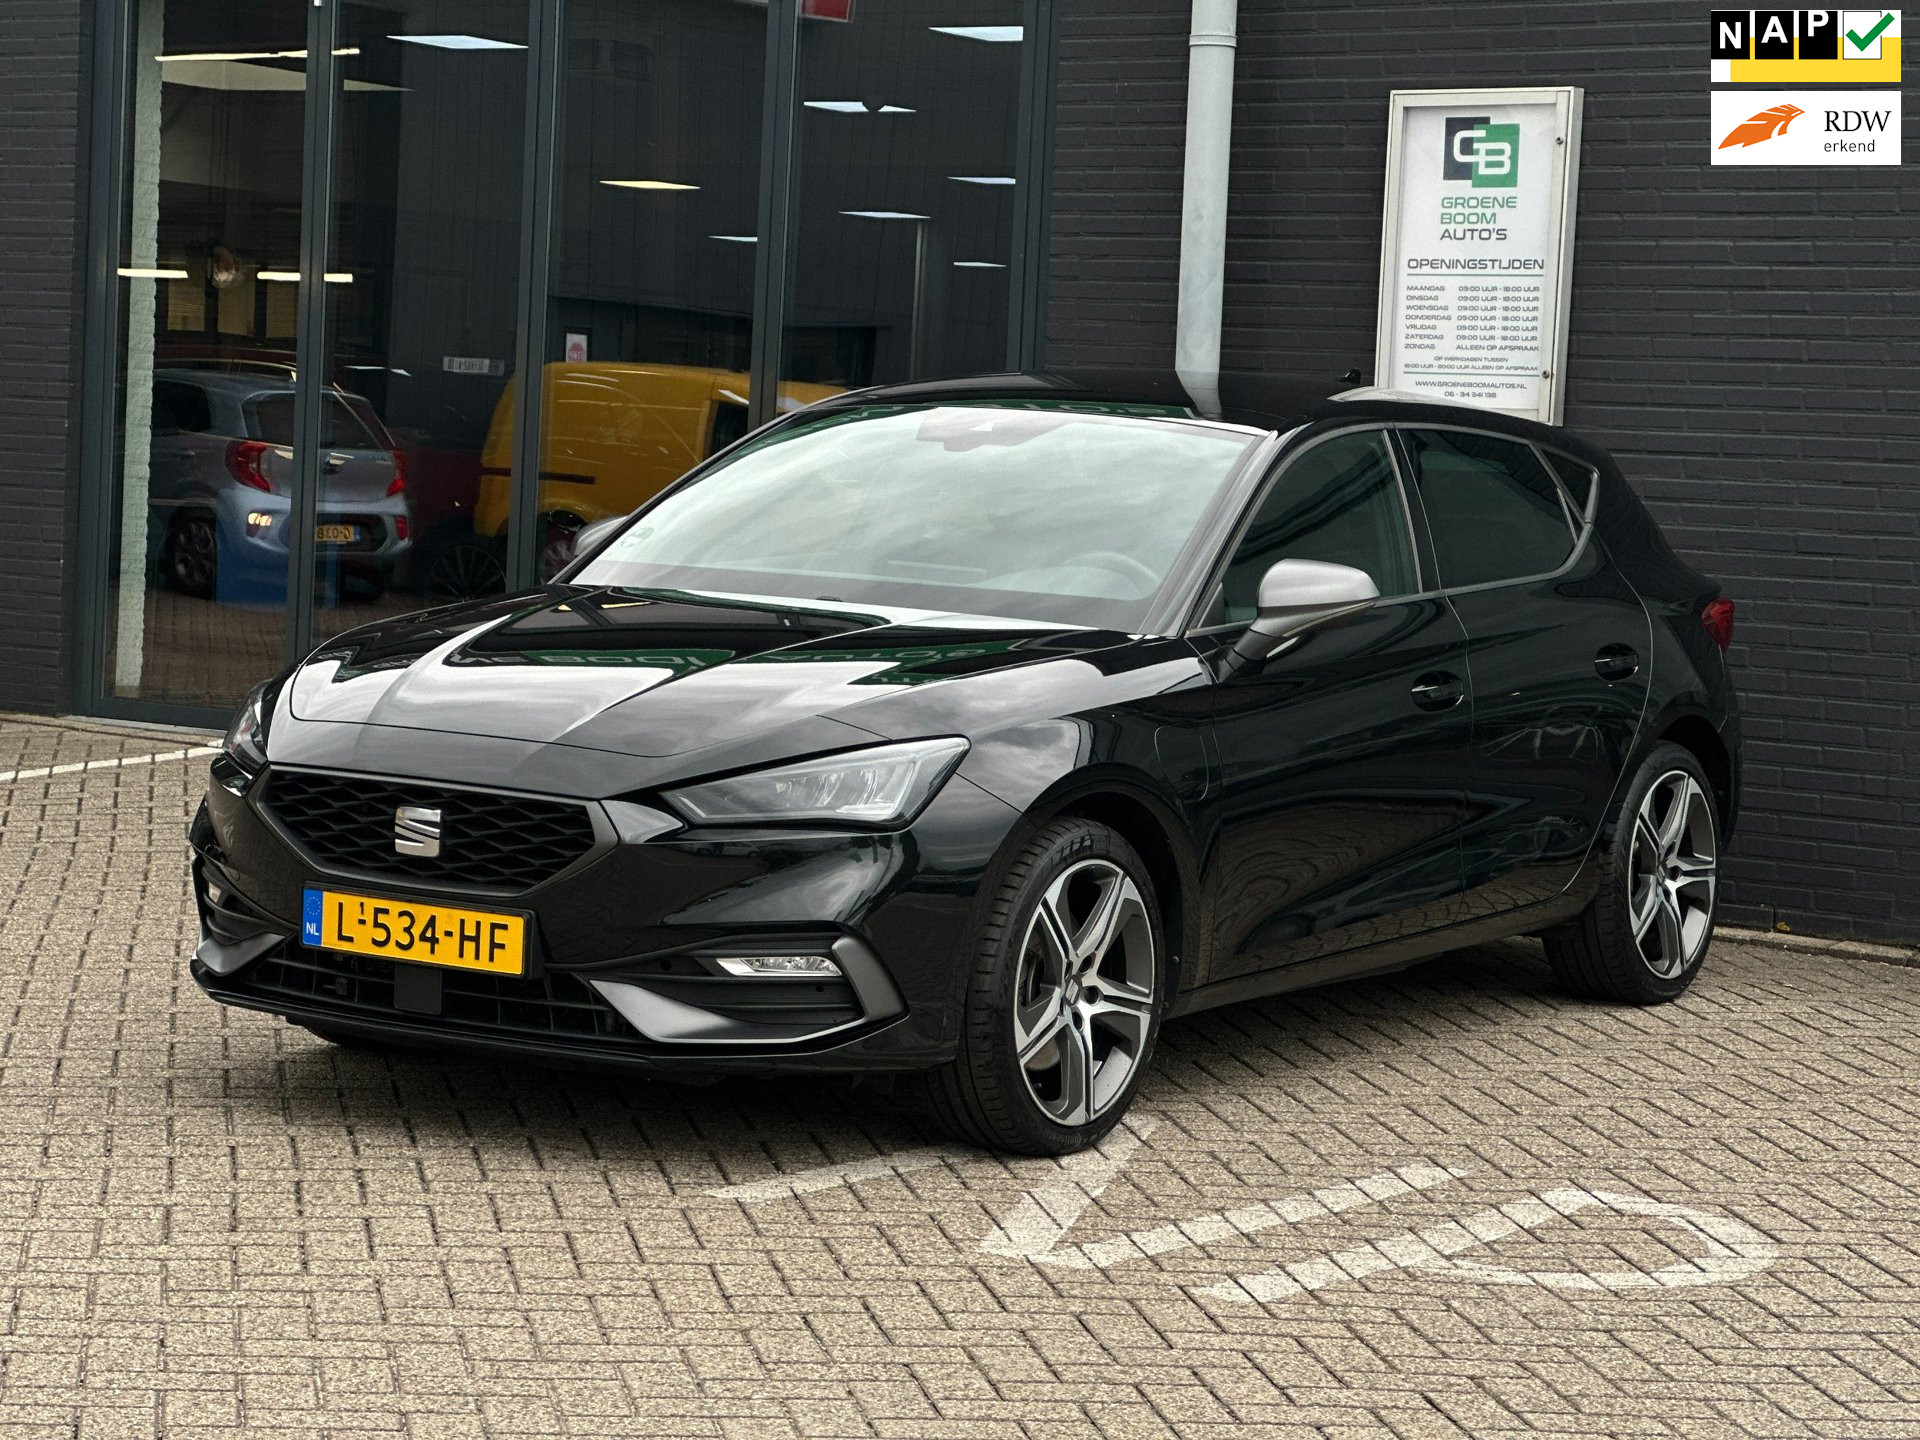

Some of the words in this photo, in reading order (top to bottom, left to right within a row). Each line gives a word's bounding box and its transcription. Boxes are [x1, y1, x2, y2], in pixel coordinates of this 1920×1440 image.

[1441, 196, 1518, 209] GROENE
[1440, 212, 1497, 225] BOOM
[1440, 228, 1508, 241] AUTO'S
[1407, 258, 1545, 270] OPENINGSTIJDEN
[305, 921, 320, 936] NL
[337, 901, 509, 963] L-534-HF
